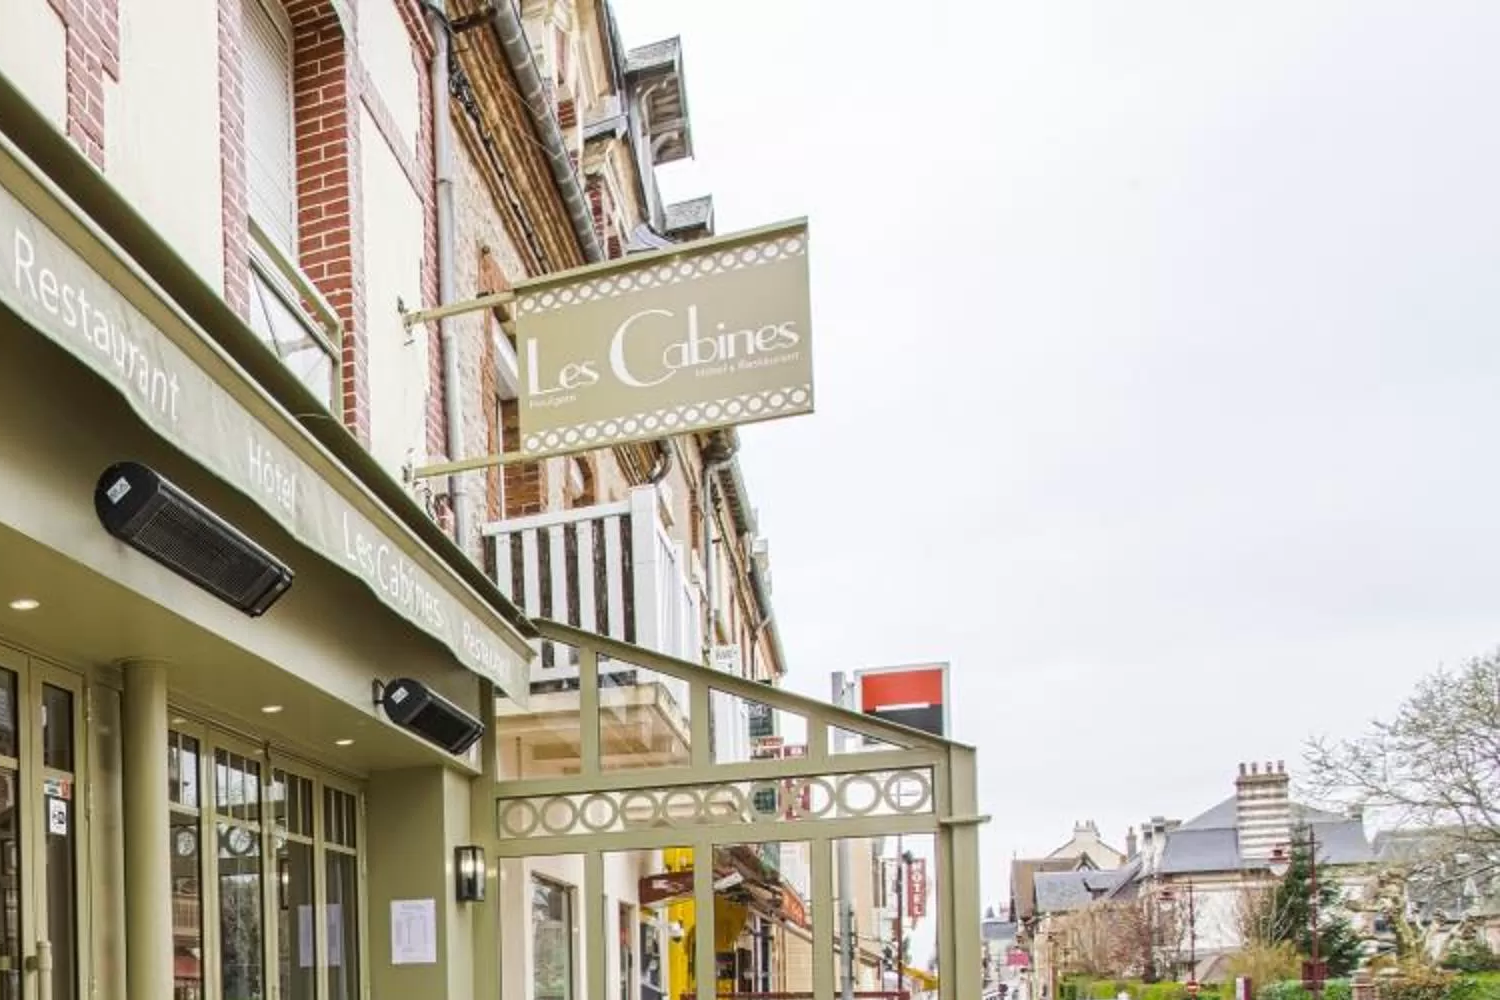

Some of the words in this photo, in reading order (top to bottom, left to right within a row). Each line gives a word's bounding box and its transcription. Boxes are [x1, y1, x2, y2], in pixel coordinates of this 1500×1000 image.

[14, 226, 180, 422] Restaurant
[526, 337, 599, 395] Les
[609, 304, 800, 387] Cabines
[247, 436, 296, 519] Hôtel
[343, 511, 375, 577] Les
[377, 543, 445, 627] Cabines
